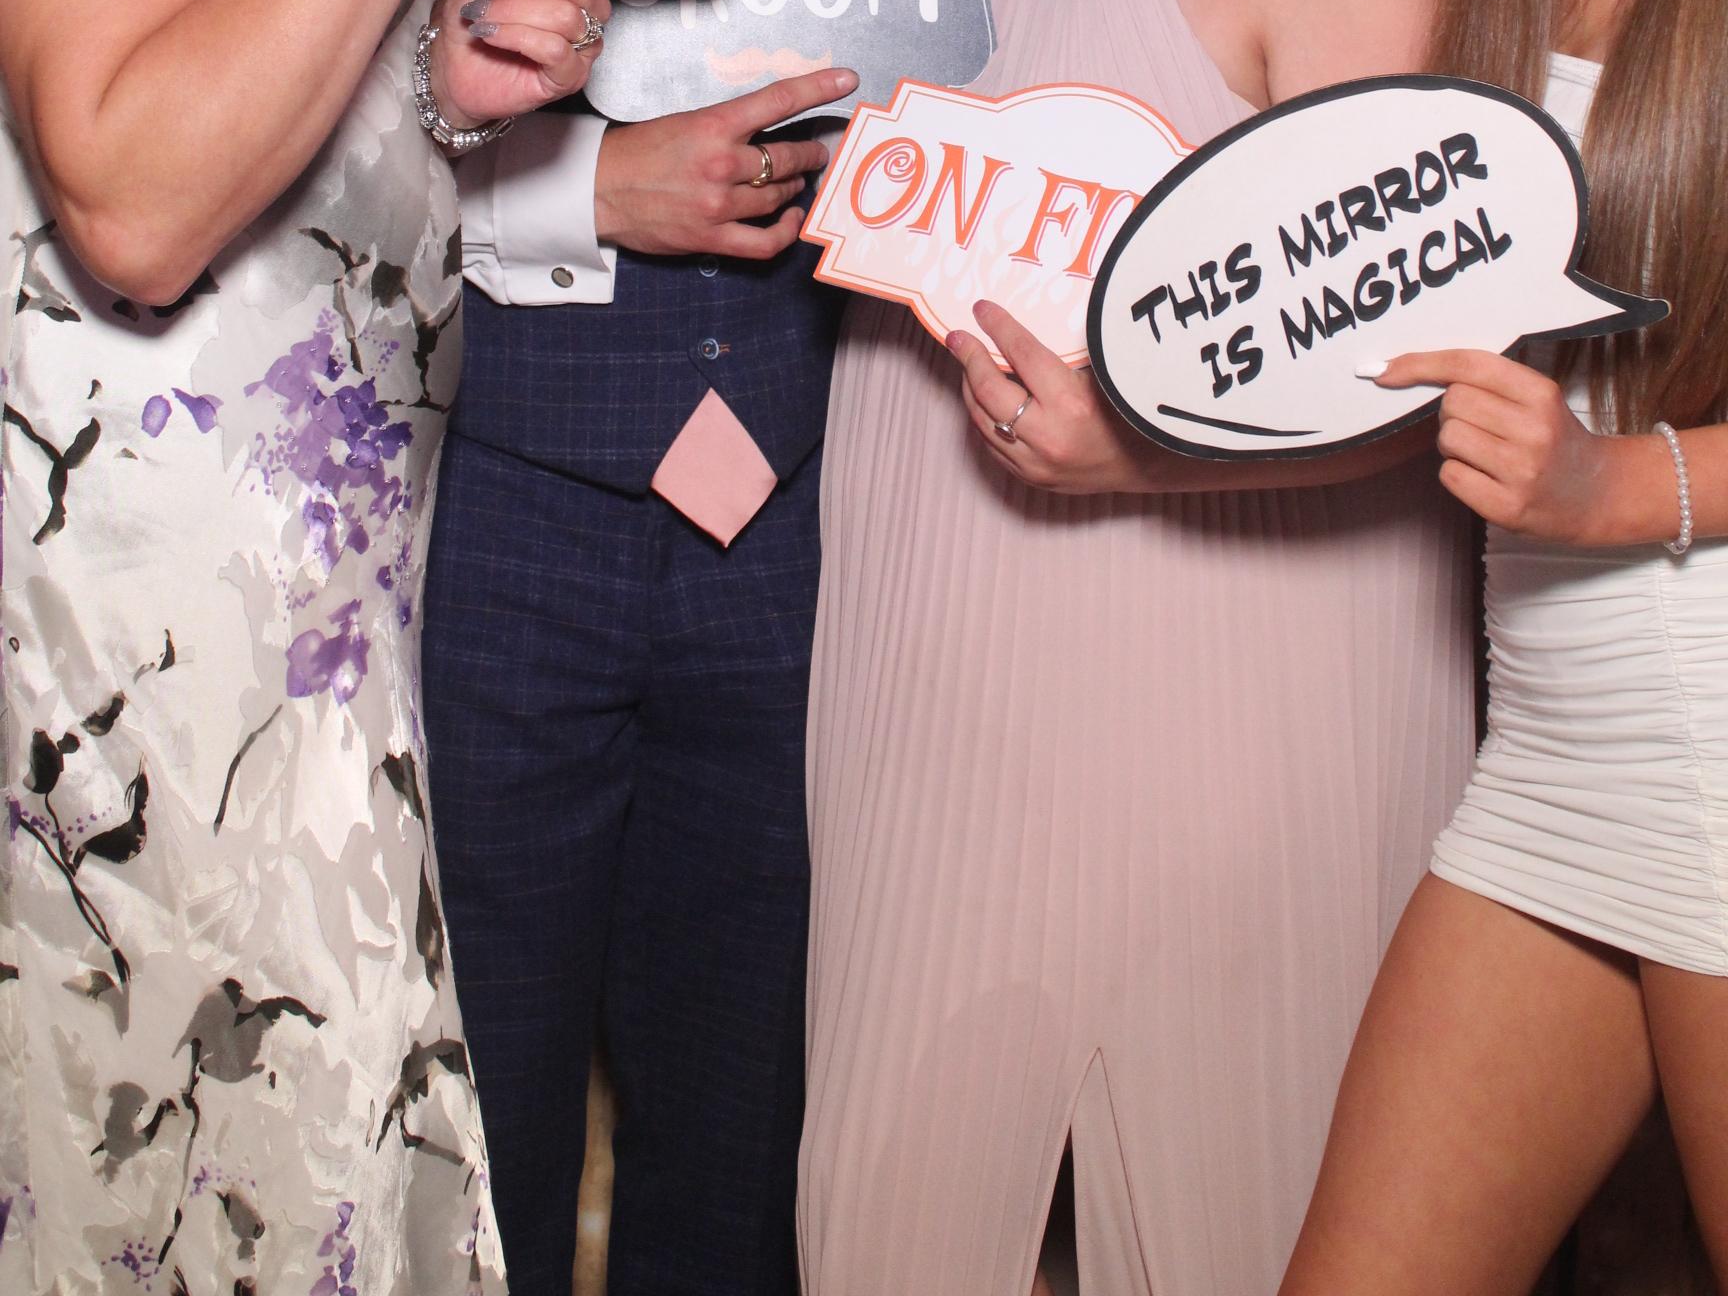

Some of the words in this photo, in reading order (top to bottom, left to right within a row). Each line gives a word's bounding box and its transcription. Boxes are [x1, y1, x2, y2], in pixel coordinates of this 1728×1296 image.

[849, 136, 1014, 249] ON
[1008, 167, 1145, 281] FI
[1130, 242, 1262, 342] THIS
[1278, 133, 1488, 277] MIRROR
[1200, 325, 1263, 398] IS
[1280, 207, 1512, 359] MAGICAL
